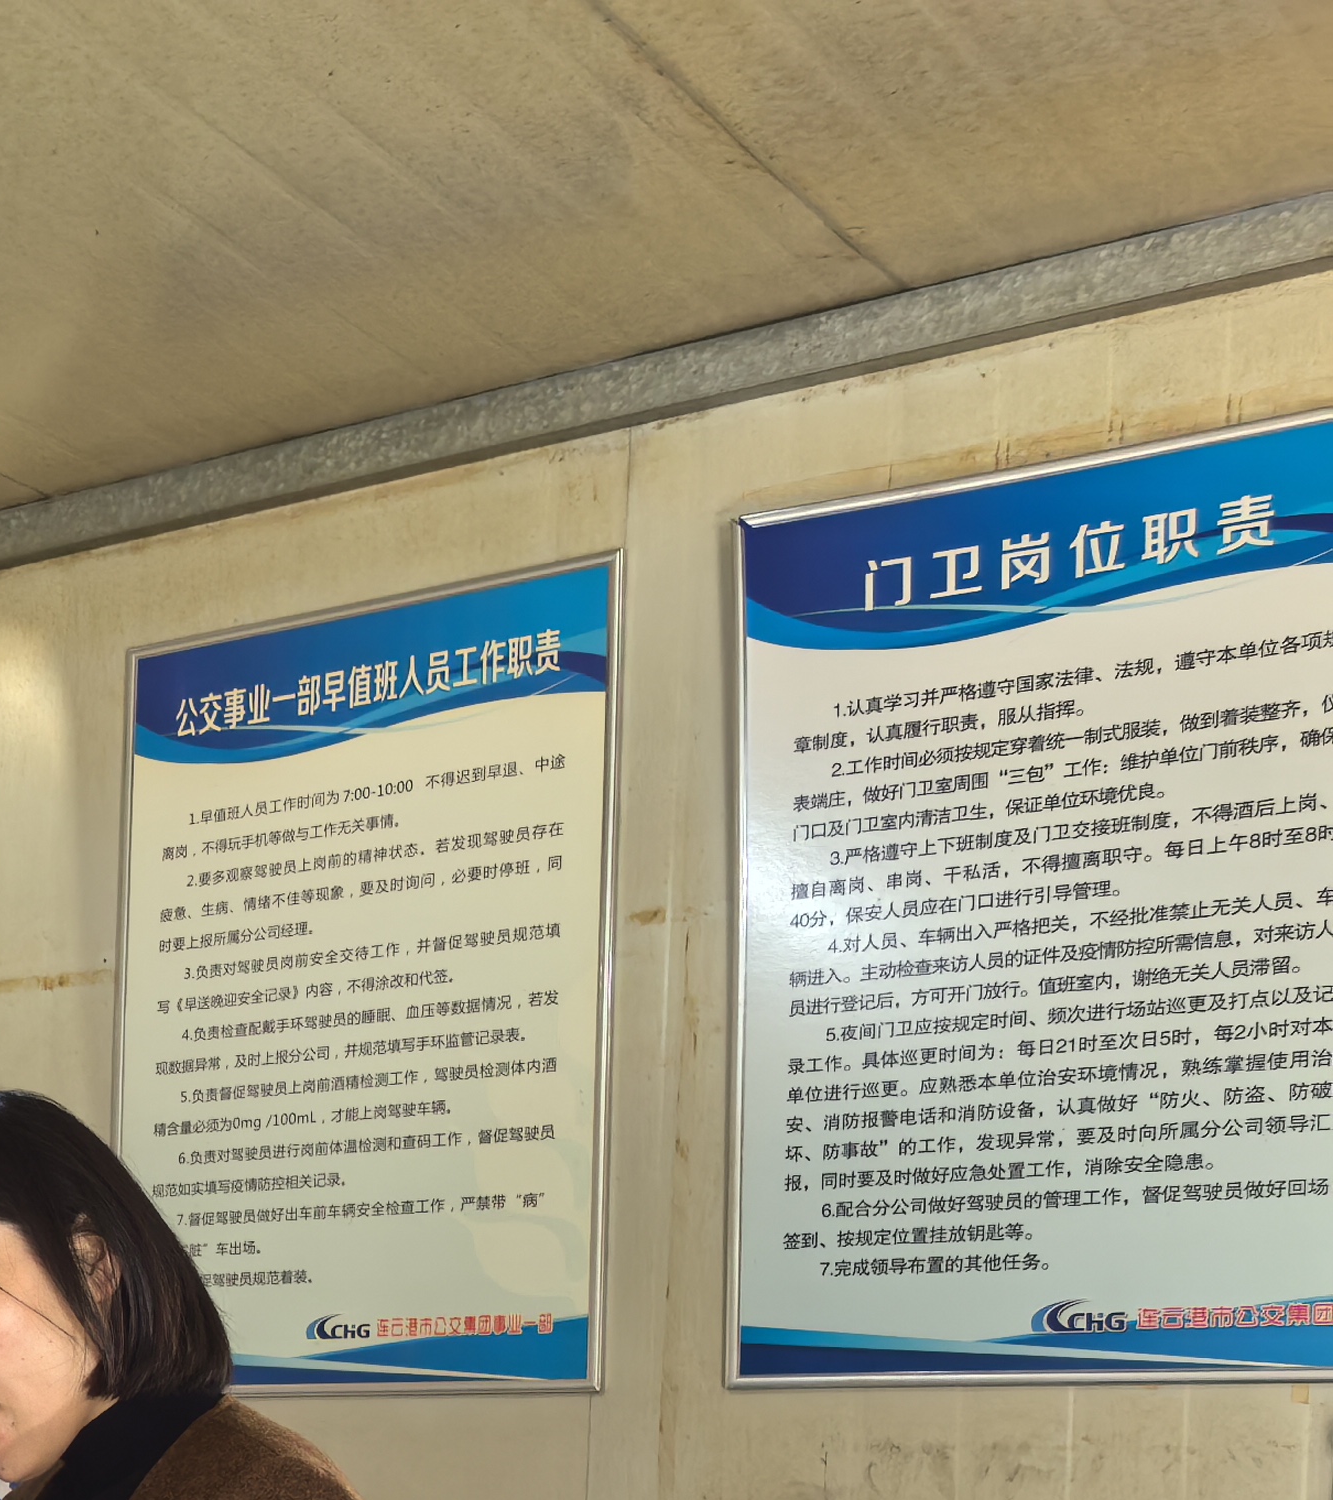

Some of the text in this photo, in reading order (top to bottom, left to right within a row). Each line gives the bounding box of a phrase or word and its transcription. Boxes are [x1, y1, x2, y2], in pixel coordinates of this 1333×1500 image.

[864, 494, 1275, 612] 门卫岗位职责
[176, 629, 561, 738] 公交事业一部早值班人员工作职责
[426, 754, 565, 789] 不得迟到早退、中途
[152, 1173, 345, 1200] 规范如实填写疫情防控相关记录。
[377, 1313, 554, 1337] 连云港市公交集团事业一部
